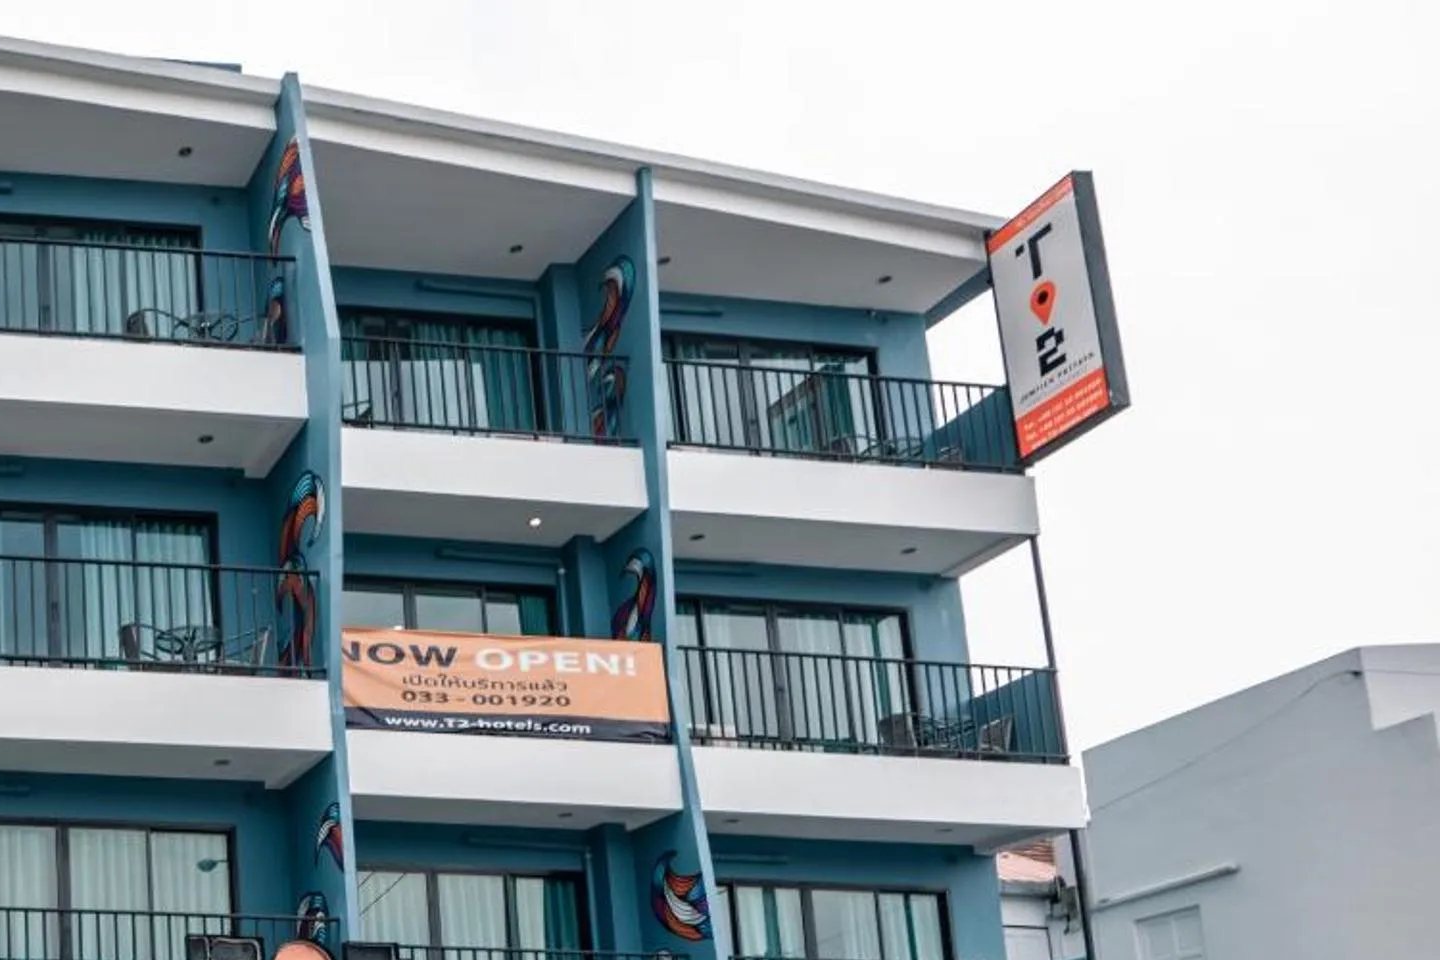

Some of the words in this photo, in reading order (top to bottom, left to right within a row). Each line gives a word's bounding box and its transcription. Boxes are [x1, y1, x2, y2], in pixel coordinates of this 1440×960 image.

[340, 641, 458, 667] NOW
[475, 648, 638, 677] OPEN!
[384, 714, 592, 735] www.T2-hotels.com
